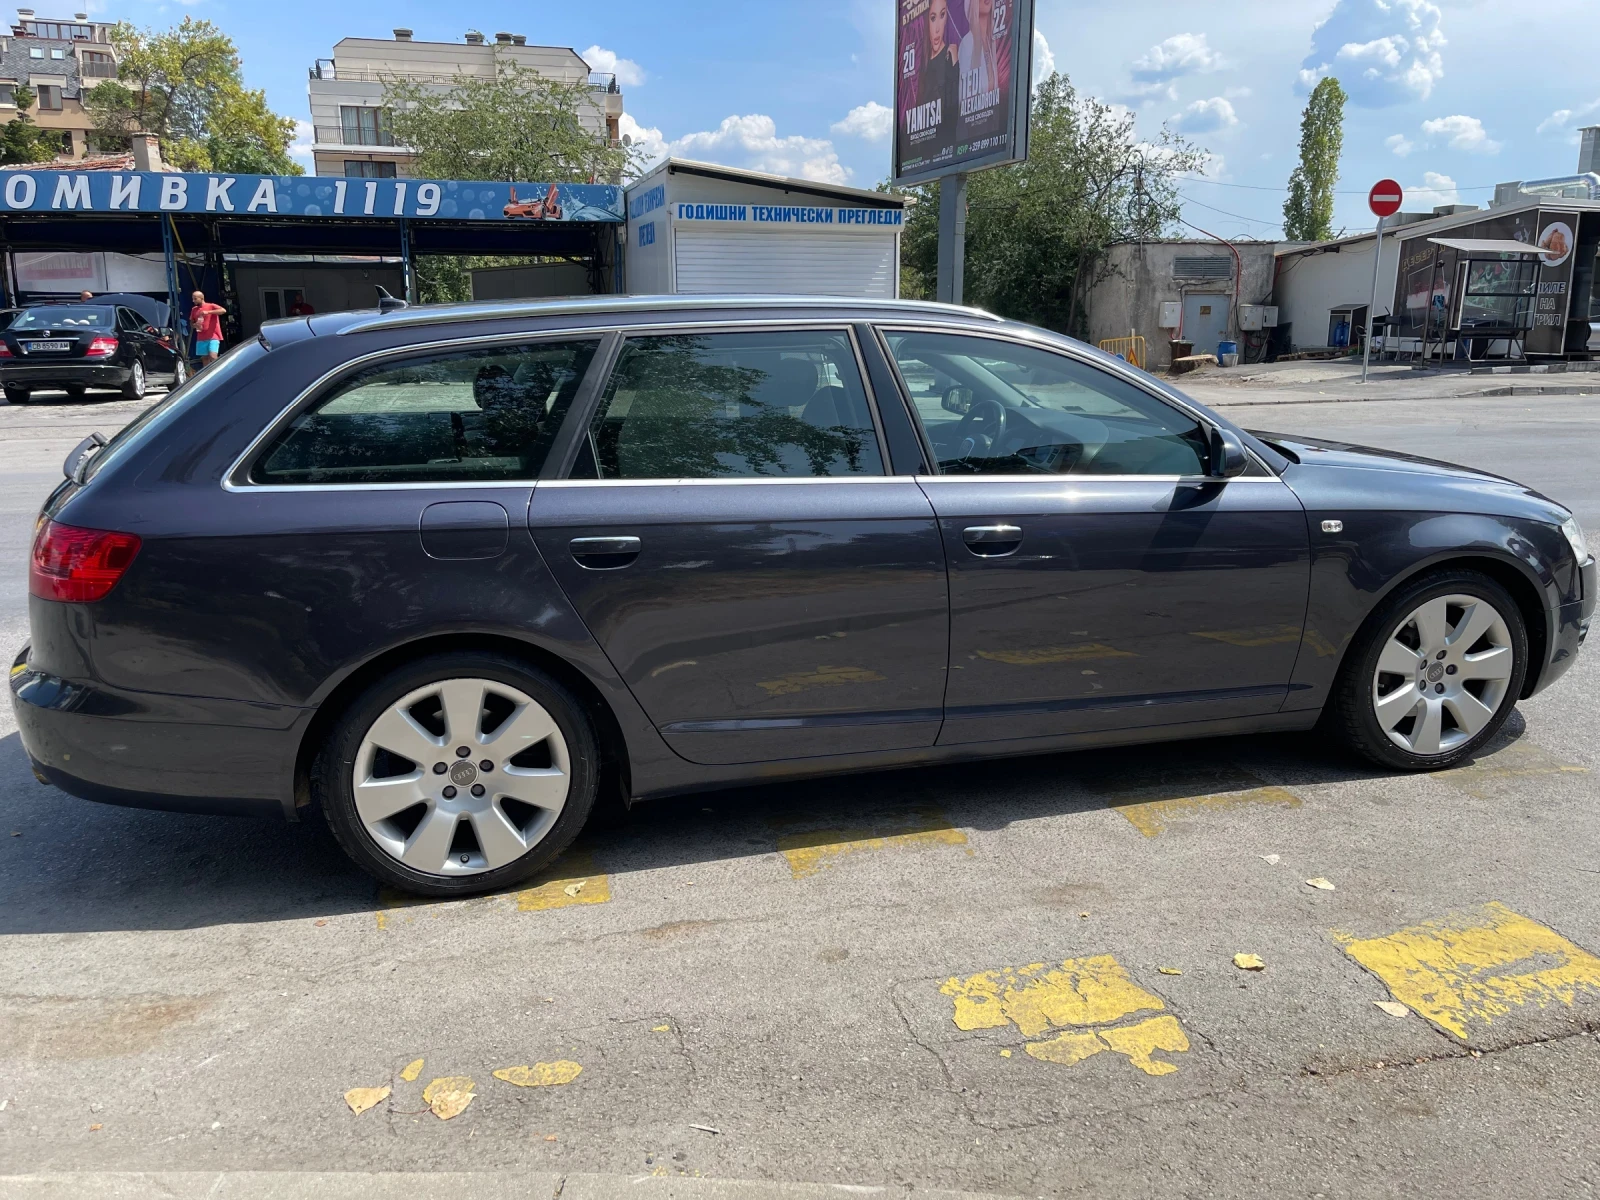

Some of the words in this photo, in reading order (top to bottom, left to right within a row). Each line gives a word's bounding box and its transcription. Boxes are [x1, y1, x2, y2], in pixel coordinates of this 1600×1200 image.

[993, 4, 1006, 34] 22
[903, 48, 915, 73] 20
[961, 66, 982, 99] TEDI
[905, 98, 942, 134] YANITSA
[960, 88, 1000, 116] ALEXANDROVA
[4, 174, 279, 214] ОМИВКА
[332, 180, 443, 216] 1119
[678, 204, 747, 221] ГОДИШНИ
[752, 206, 833, 224] ТЕХНИЧЕСКИ
[838, 208, 902, 225] ПРЕГЛЕДИ
[1539, 297, 1556, 310] НА
